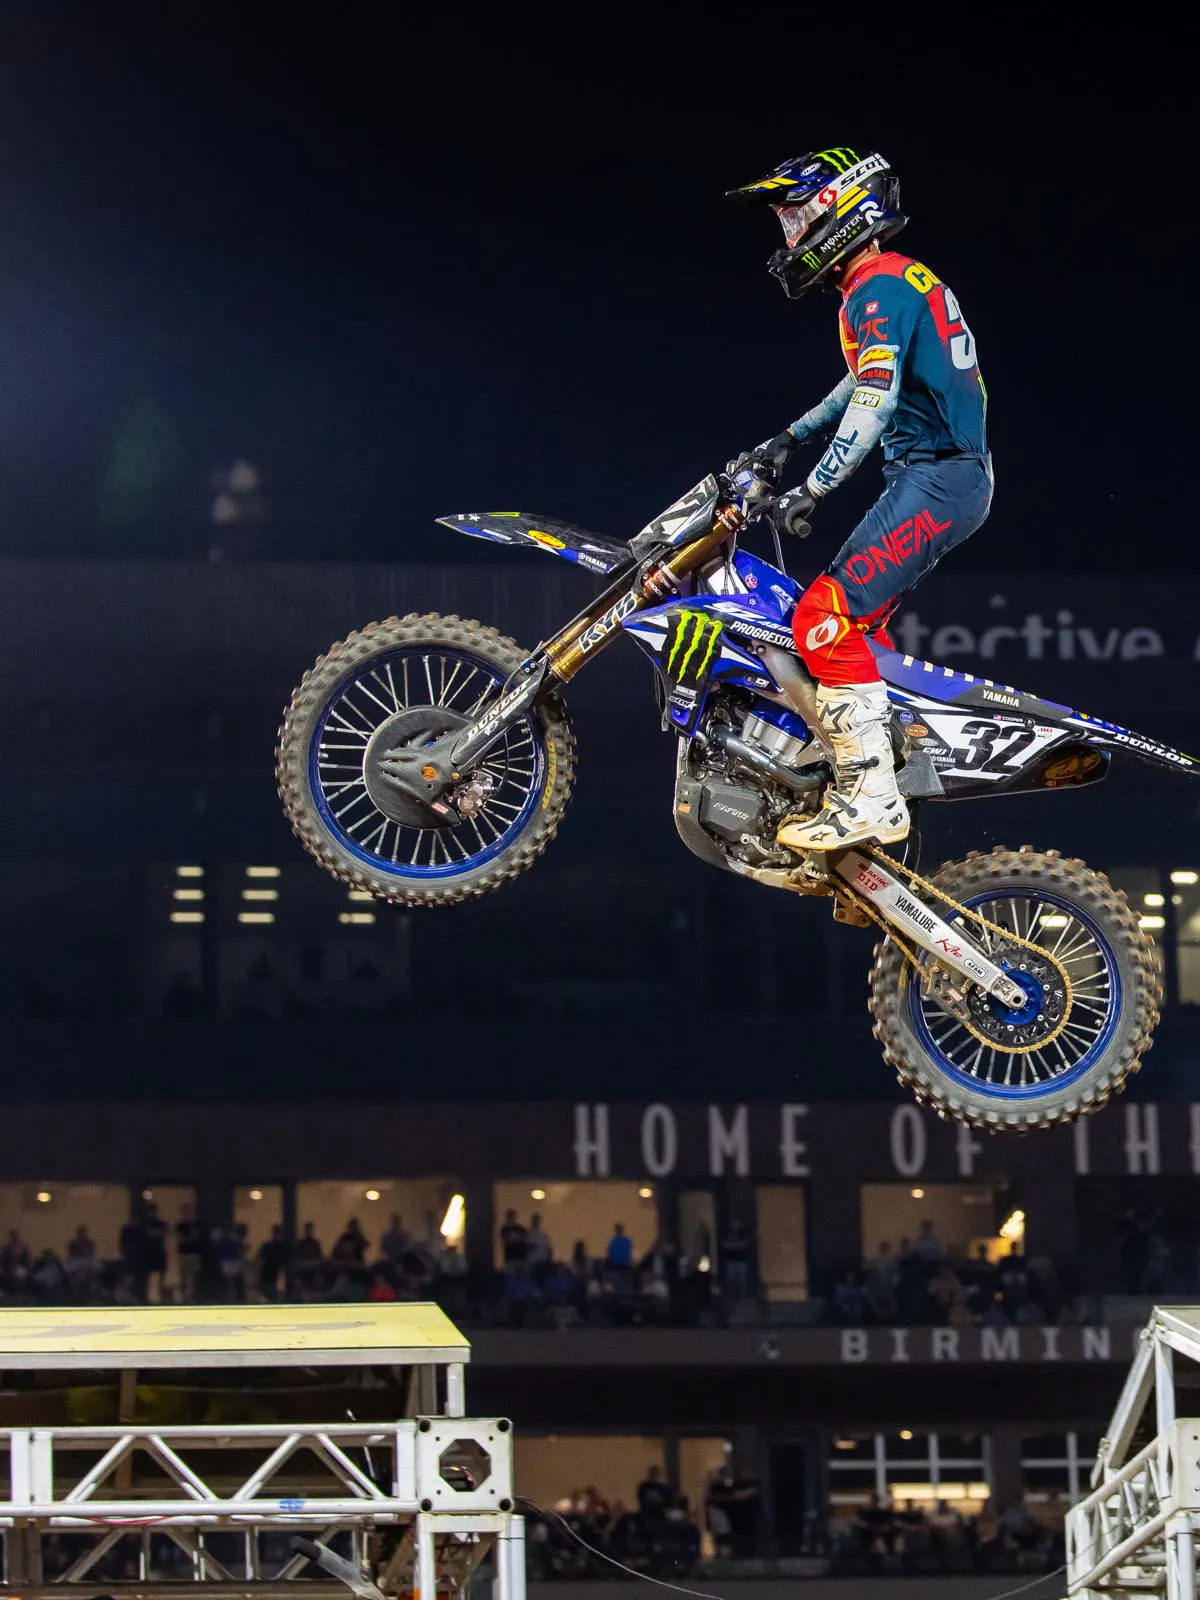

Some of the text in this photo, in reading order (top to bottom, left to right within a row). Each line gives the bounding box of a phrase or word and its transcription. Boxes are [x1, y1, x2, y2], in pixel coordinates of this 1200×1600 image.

[820, 213, 863, 253] MONSTER
[578, 590, 639, 653] KYB
[982, 688, 1020, 708] YAMAHA
[953, 719, 1037, 772] 32
[1114, 731, 1193, 767] DUNLOP
[894, 895, 938, 935] YAMALUBE
[967, 962, 983, 976] AFAM
[573, 1103, 811, 1176] HOME
[889, 1102, 982, 1176] OF
[840, 1326, 1149, 1363] BIRMIN
